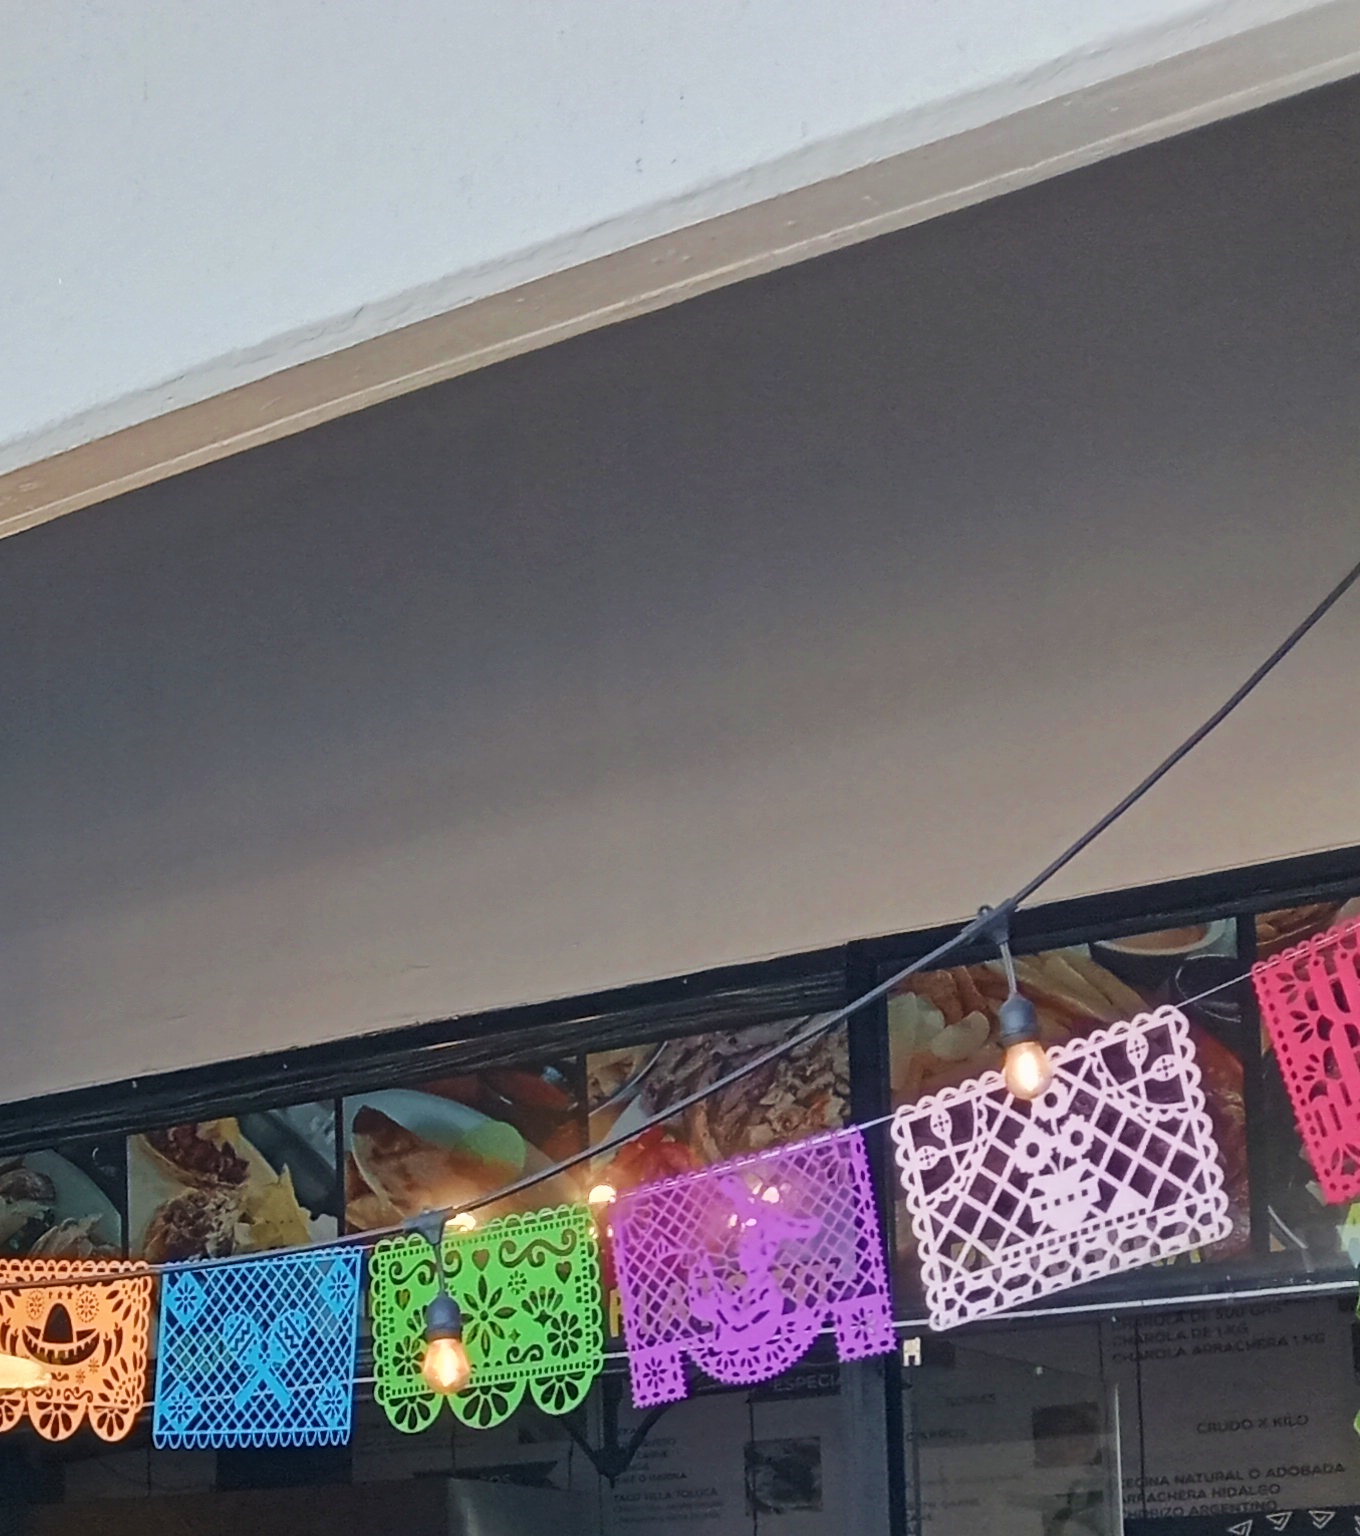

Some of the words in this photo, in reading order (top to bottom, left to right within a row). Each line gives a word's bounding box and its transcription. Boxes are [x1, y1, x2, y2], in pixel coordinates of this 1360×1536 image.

[1174, 1471, 1243, 1485] NATURAL
[1248, 1468, 1260, 1480] O
[1265, 1462, 1346, 1479] ADOBADA
